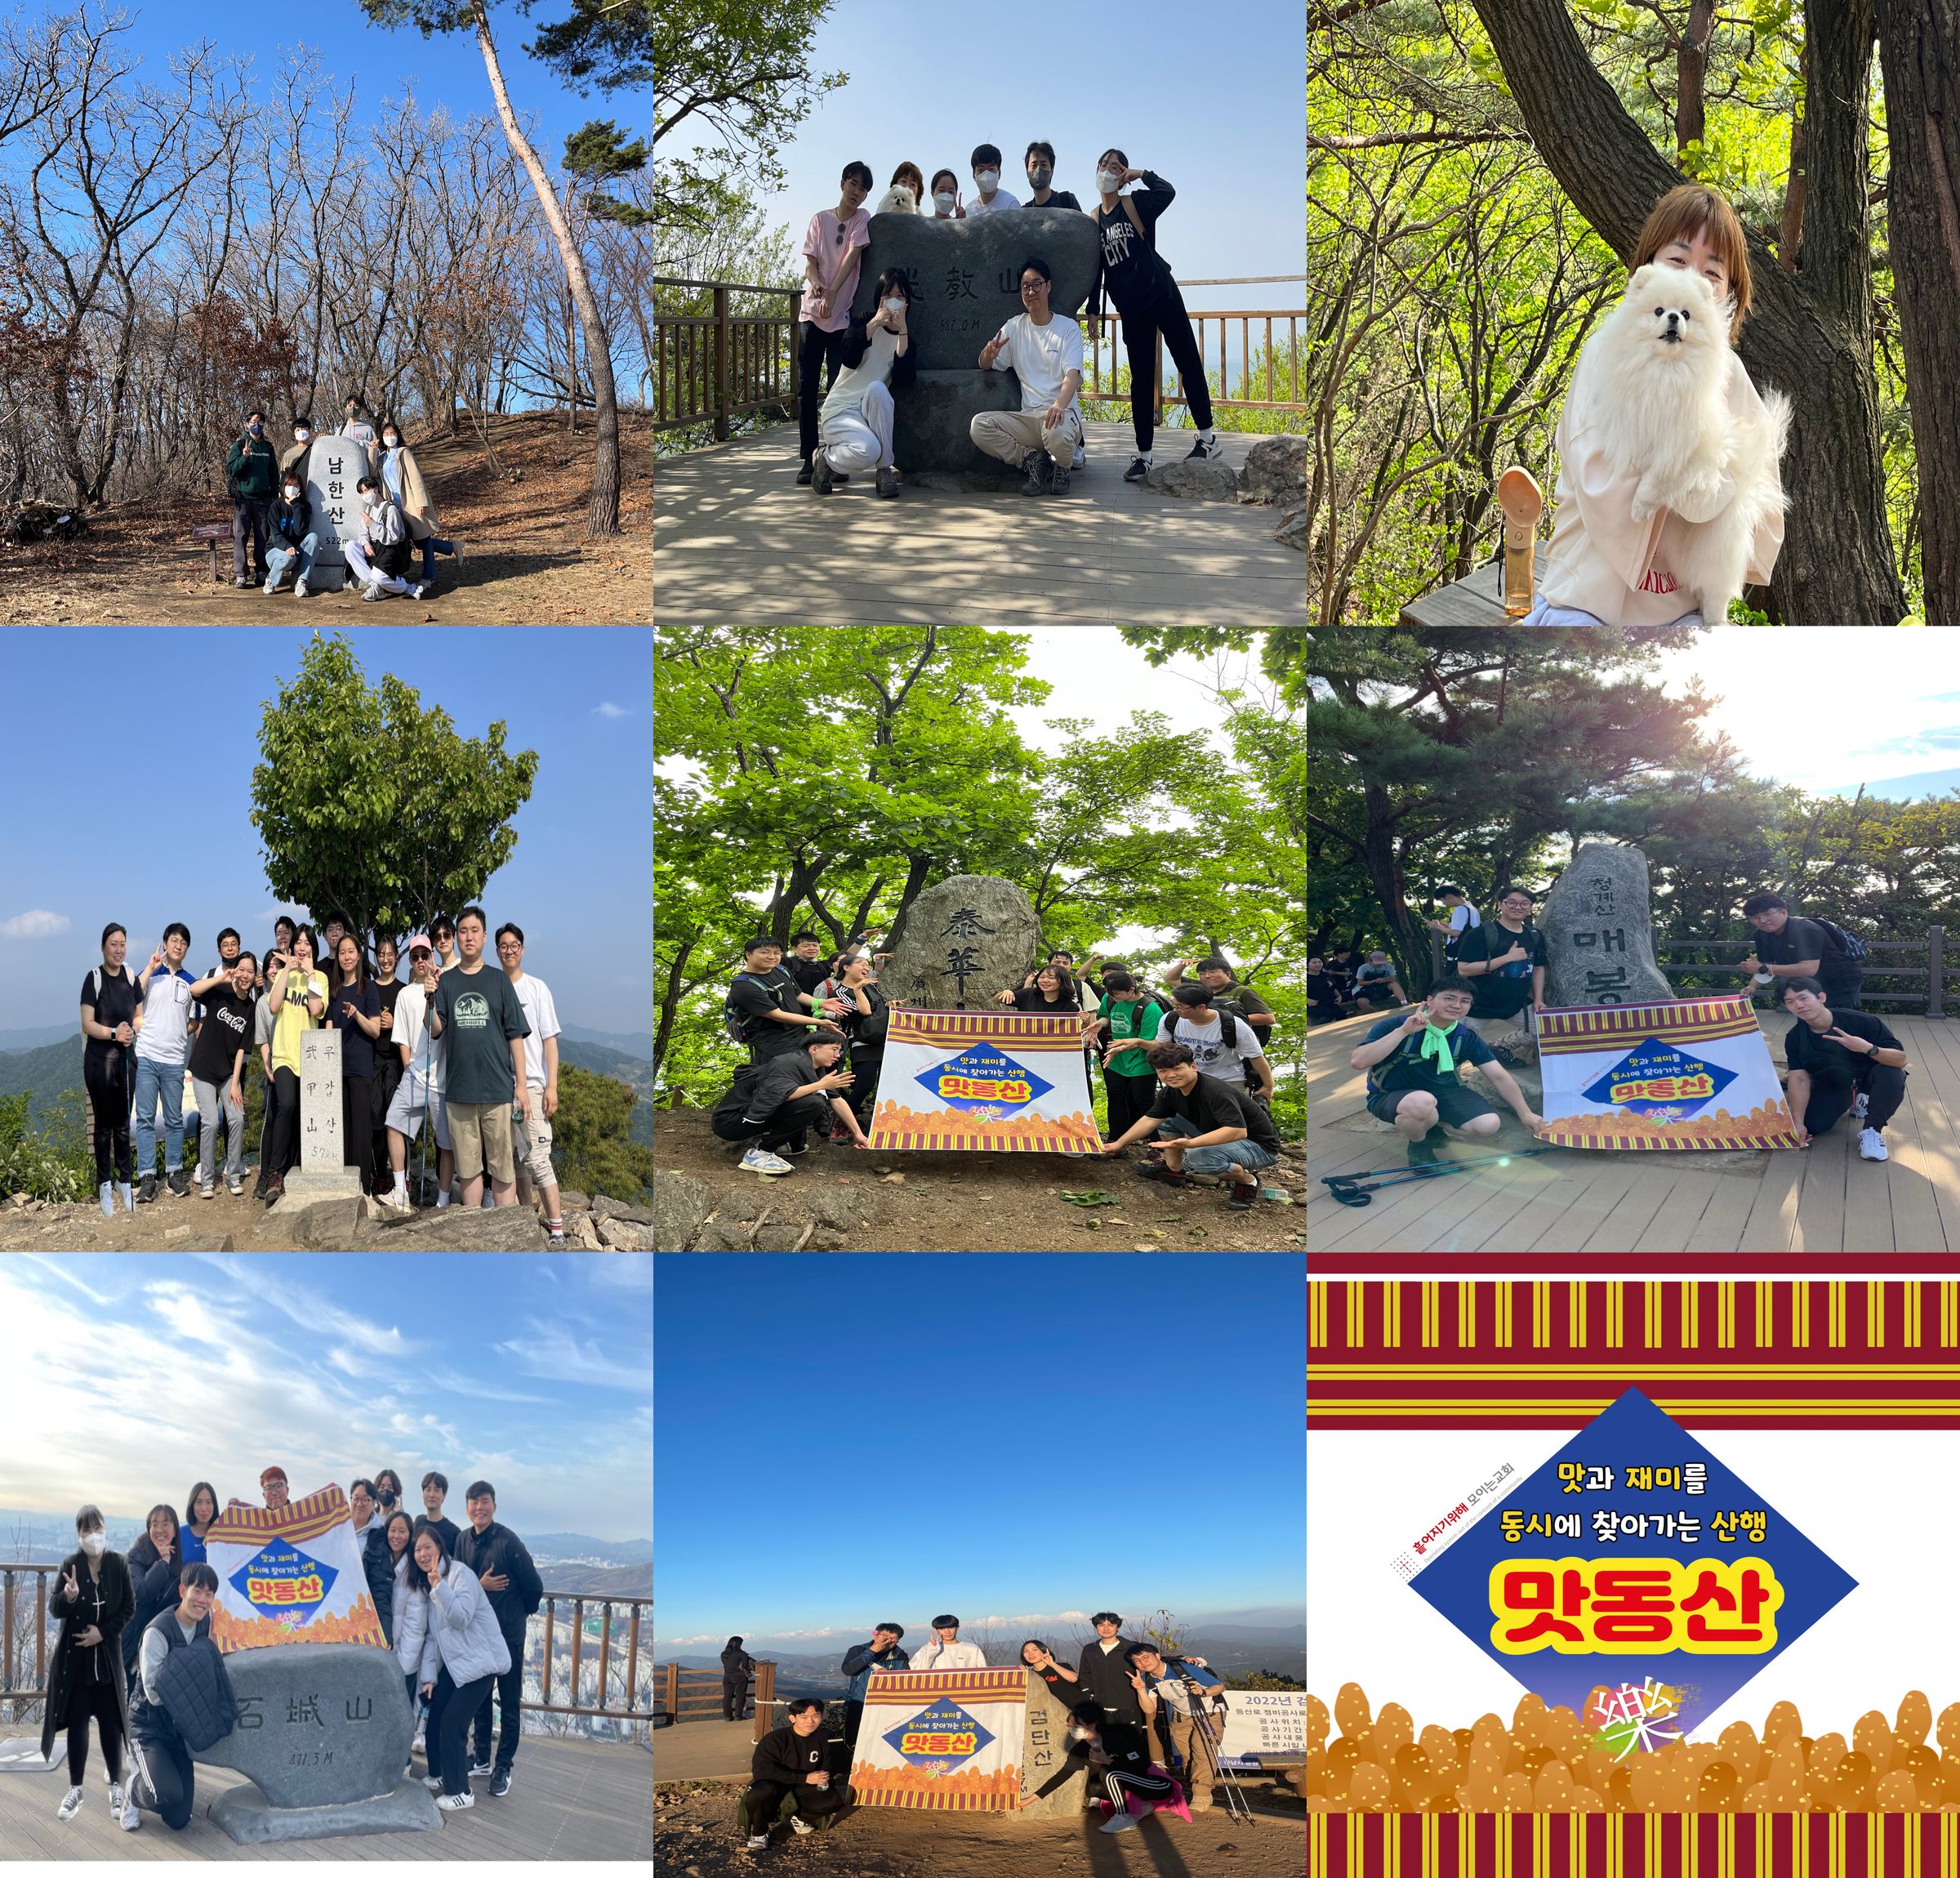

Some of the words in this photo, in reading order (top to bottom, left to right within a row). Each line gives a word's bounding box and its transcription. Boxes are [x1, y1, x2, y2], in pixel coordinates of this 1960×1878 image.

[1107, 222, 1134, 243] ANGELES
[1104, 238, 1130, 266] CITY
[328, 457, 345, 525] 남한산
[326, 537, 350, 545] 522m
[1590, 877, 1616, 917] 청계산
[939, 908, 996, 1010] 泰華
[1573, 928, 1632, 1004] 매봉
[943, 1064, 968, 1074] 동시에
[970, 1068, 1004, 1077] 찾아가는
[1007, 1069, 1026, 1077] 산행
[960, 1056, 978, 1066] 맛과
[981, 1058, 1006, 1066] 재미를
[1611, 1071, 1640, 1081] 동시에
[1643, 1066, 1682, 1077] 찾아가는
[1684, 1063, 1704, 1073] 산행
[1628, 1057, 1649, 1067] 맛과
[1652, 1054, 1681, 1064] 재미를
[323, 1046, 336, 1134] 무갑산
[942, 1076, 1029, 1101] 맛동산
[1614, 1075, 1709, 1103] 맛동산
[1557, 1463, 1615, 1493] 맛과
[1625, 1462, 1708, 1495] 재미를
[1412, 1501, 1469, 1555] 흩어지기위해
[1467, 1462, 1515, 1506] 모이는교회
[1477, 1502, 1493, 1517] concept
[1500, 1476, 1523, 1497] community
[1499, 1510, 1582, 1542] 동시에
[1591, 1510, 1702, 1542] 찾아가는
[1710, 1510, 1767, 1543] 산행
[249, 1577, 321, 1602] 맛동산
[1501, 1566, 1772, 1645] 맛동산
[237, 1693, 372, 1730] 石城山
[1245, 1696, 1292, 1706] 2022년
[908, 1722, 929, 1730] 동시에
[932, 1722, 959, 1730] 찾아가는
[941, 1711, 962, 1720] 재미를
[1592, 1675, 1684, 1763] 樂
[903, 1733, 974, 1753] 맛동산
[1030, 1709, 1053, 1766] 검단산
[809, 1751, 818, 1763] C
